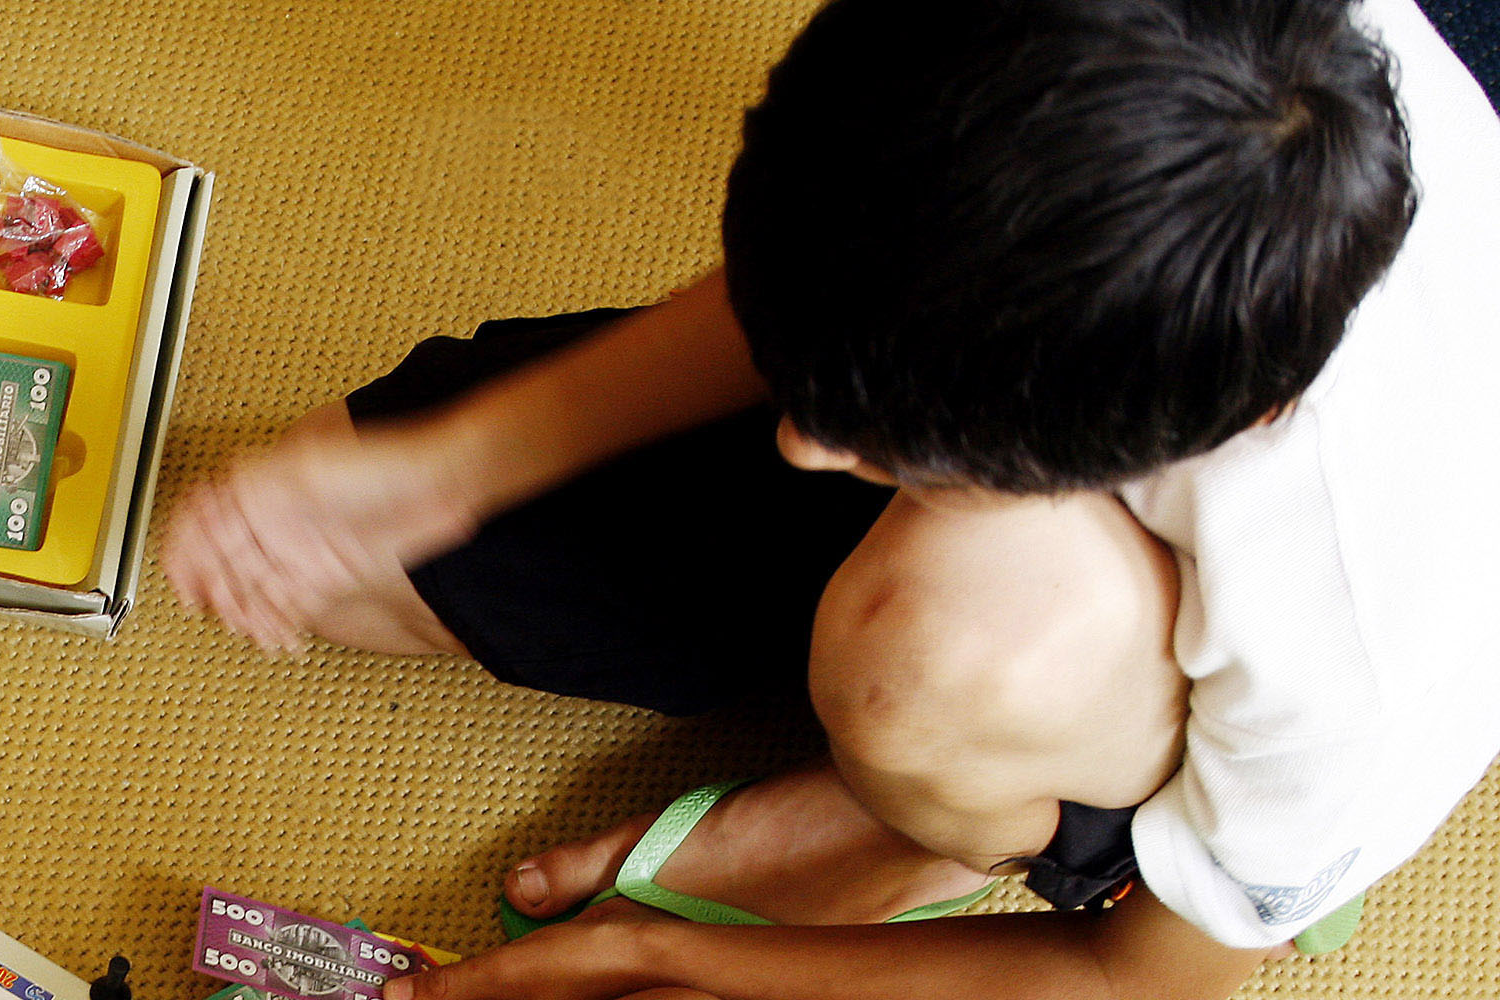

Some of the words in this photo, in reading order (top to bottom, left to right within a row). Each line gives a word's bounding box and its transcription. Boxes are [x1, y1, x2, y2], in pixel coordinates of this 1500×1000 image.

[28, 366, 51, 409] 100
[5, 497, 29, 540] 100
[211, 900, 264, 925] 500
[204, 948, 257, 975] 500
[231, 933, 282, 954] BANCO
[285, 949, 383, 985] IMOBILIARIO
[358, 943, 410, 970] 500
